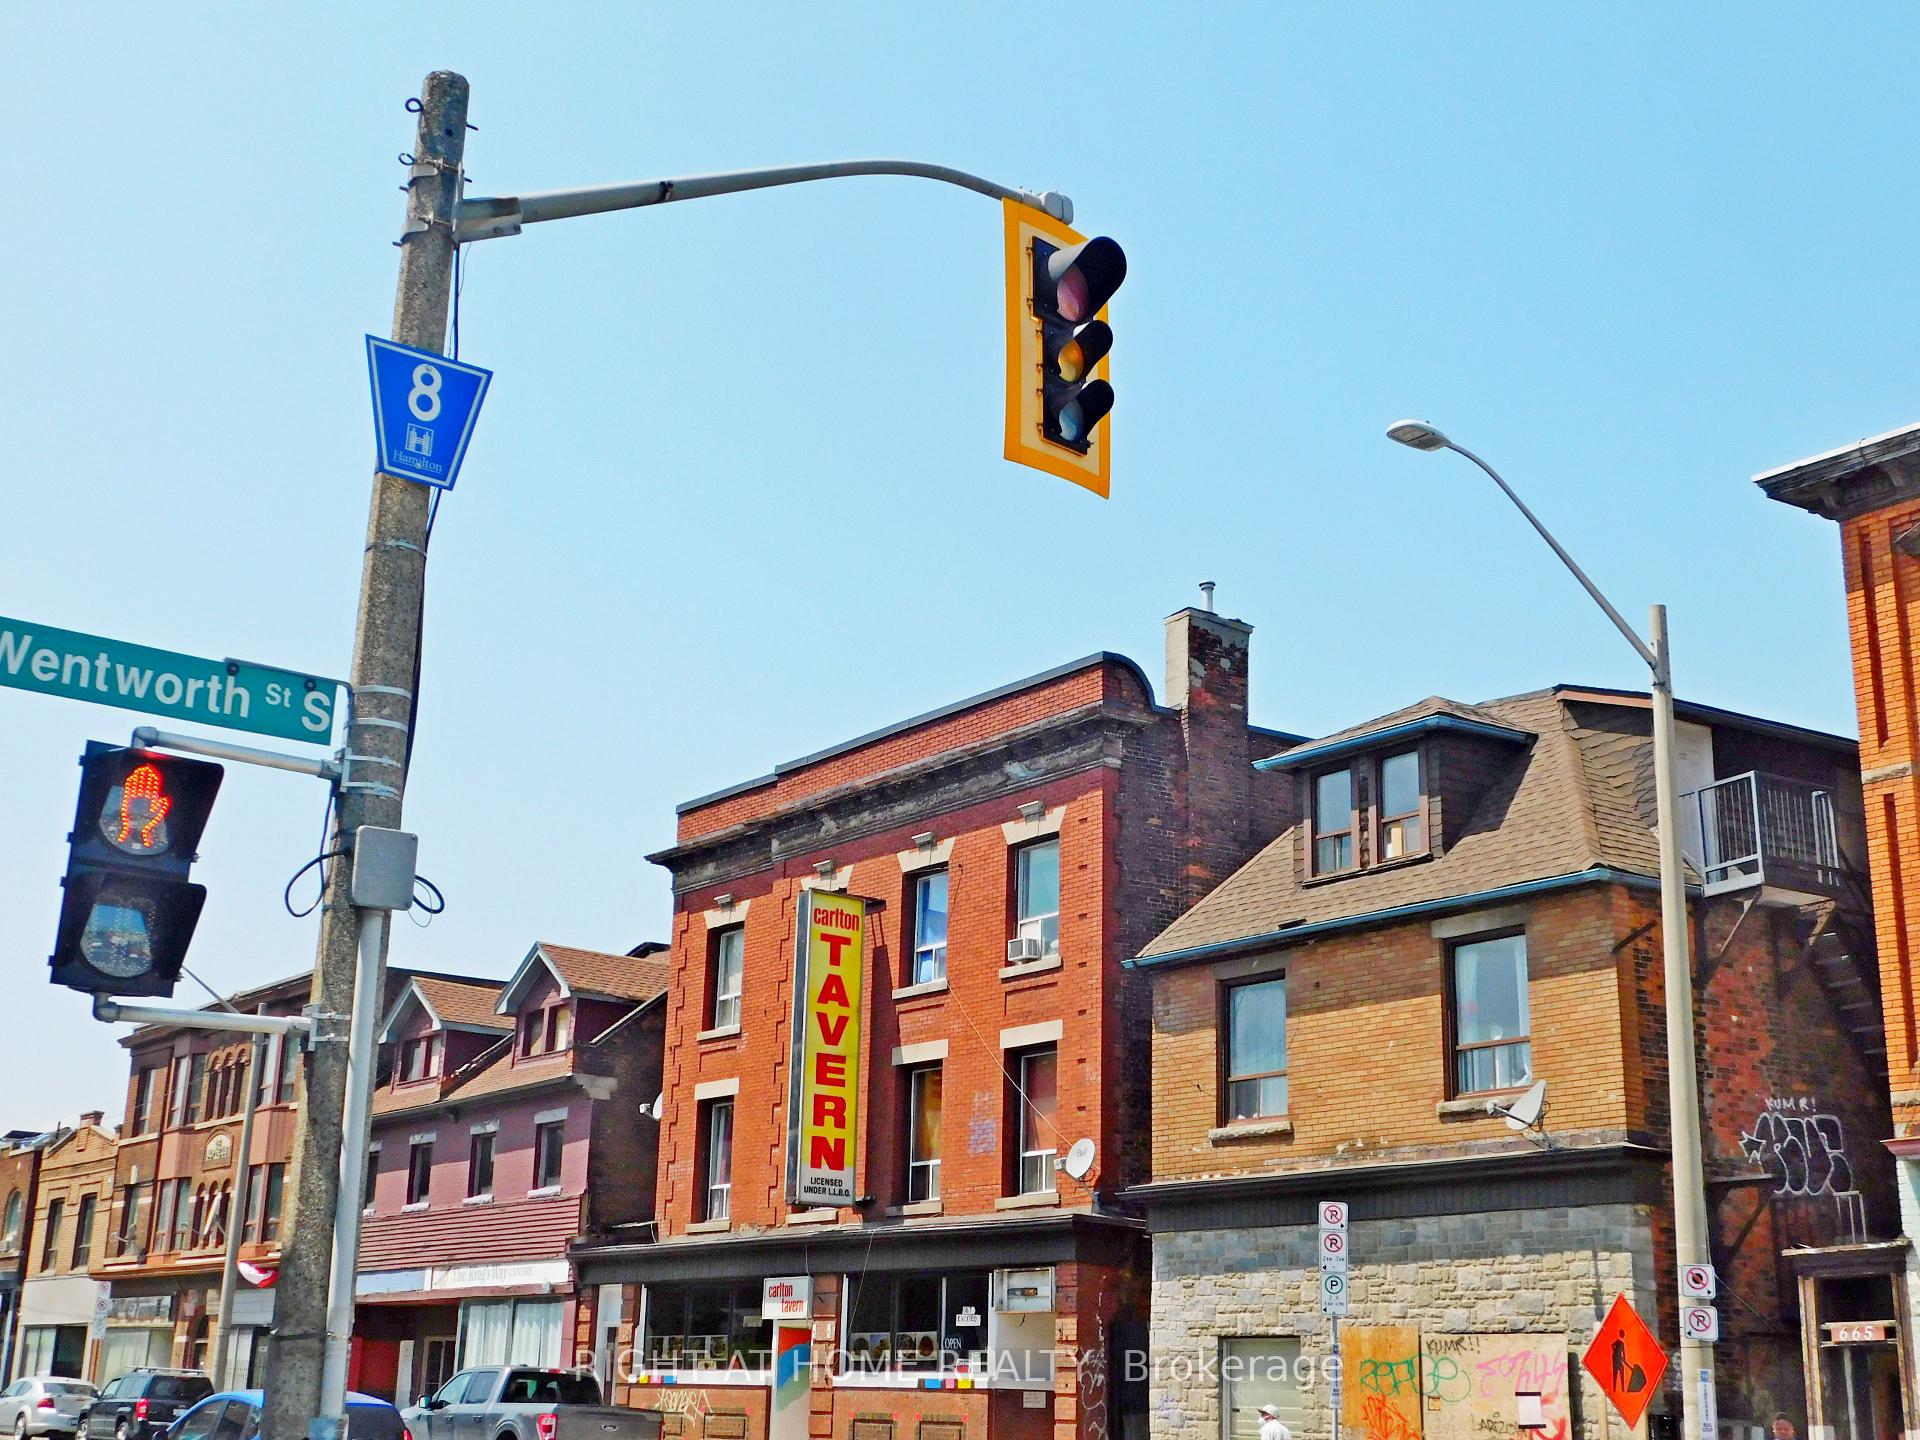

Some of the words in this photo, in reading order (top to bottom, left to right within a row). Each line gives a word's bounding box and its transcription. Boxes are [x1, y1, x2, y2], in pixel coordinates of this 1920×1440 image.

[408, 363, 442, 422] 8
[392, 449, 442, 472] Hamilton
[0, 629, 250, 719] Wentworth
[265, 682, 292, 710] St
[301, 689, 332, 732] S
[813, 906, 860, 931] carlton
[809, 932, 852, 1171] TAVERN
[810, 1177, 843, 1187] LICENSED
[803, 1186, 827, 1195] UNDER
[769, 1282, 793, 1298] carlton
[781, 1298, 804, 1313] tavern
[1839, 1326, 1873, 1341] 665
[944, 1338, 962, 1350] OPEN
